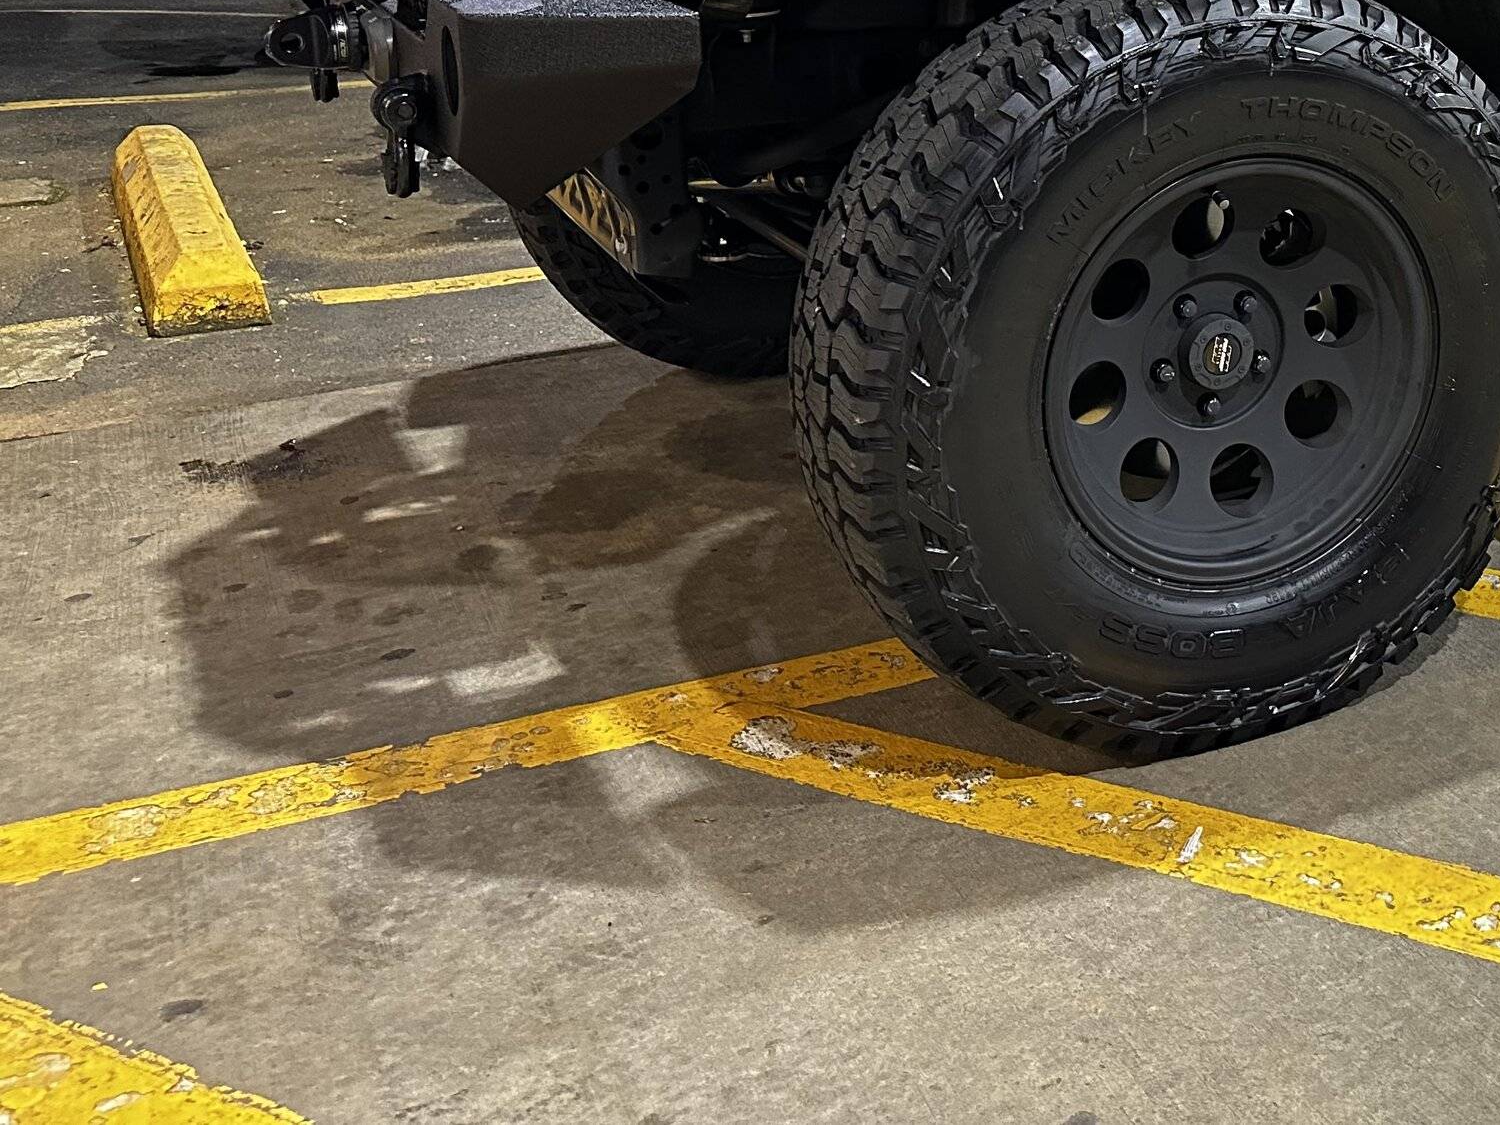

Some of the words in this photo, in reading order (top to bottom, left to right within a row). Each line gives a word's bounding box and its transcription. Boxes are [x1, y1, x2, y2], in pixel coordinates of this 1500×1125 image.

[1045, 106, 1205, 249] MICKEY
[1240, 94, 1455, 204] THOMPSON
[1099, 610, 1247, 660] BOSS
